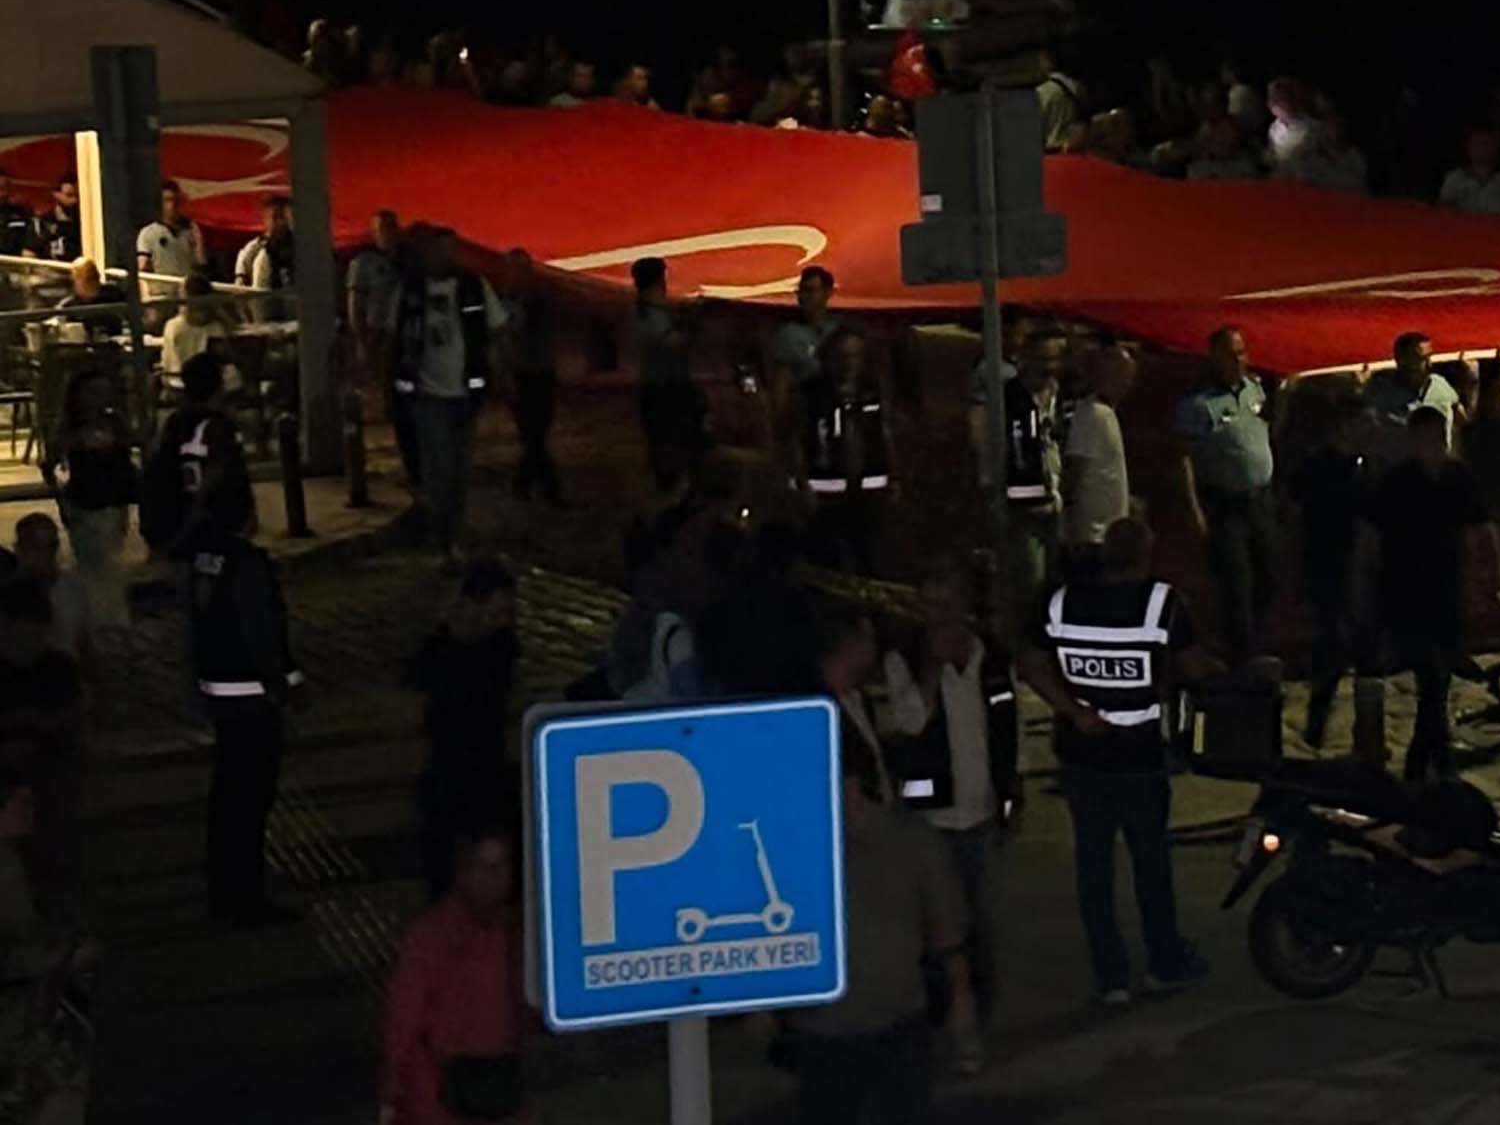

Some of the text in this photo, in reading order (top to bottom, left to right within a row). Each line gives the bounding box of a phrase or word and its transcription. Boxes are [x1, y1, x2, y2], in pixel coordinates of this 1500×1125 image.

[576, 749, 705, 947] P
[587, 953, 693, 985] SCOOTER
[700, 945, 759, 972] PARK
